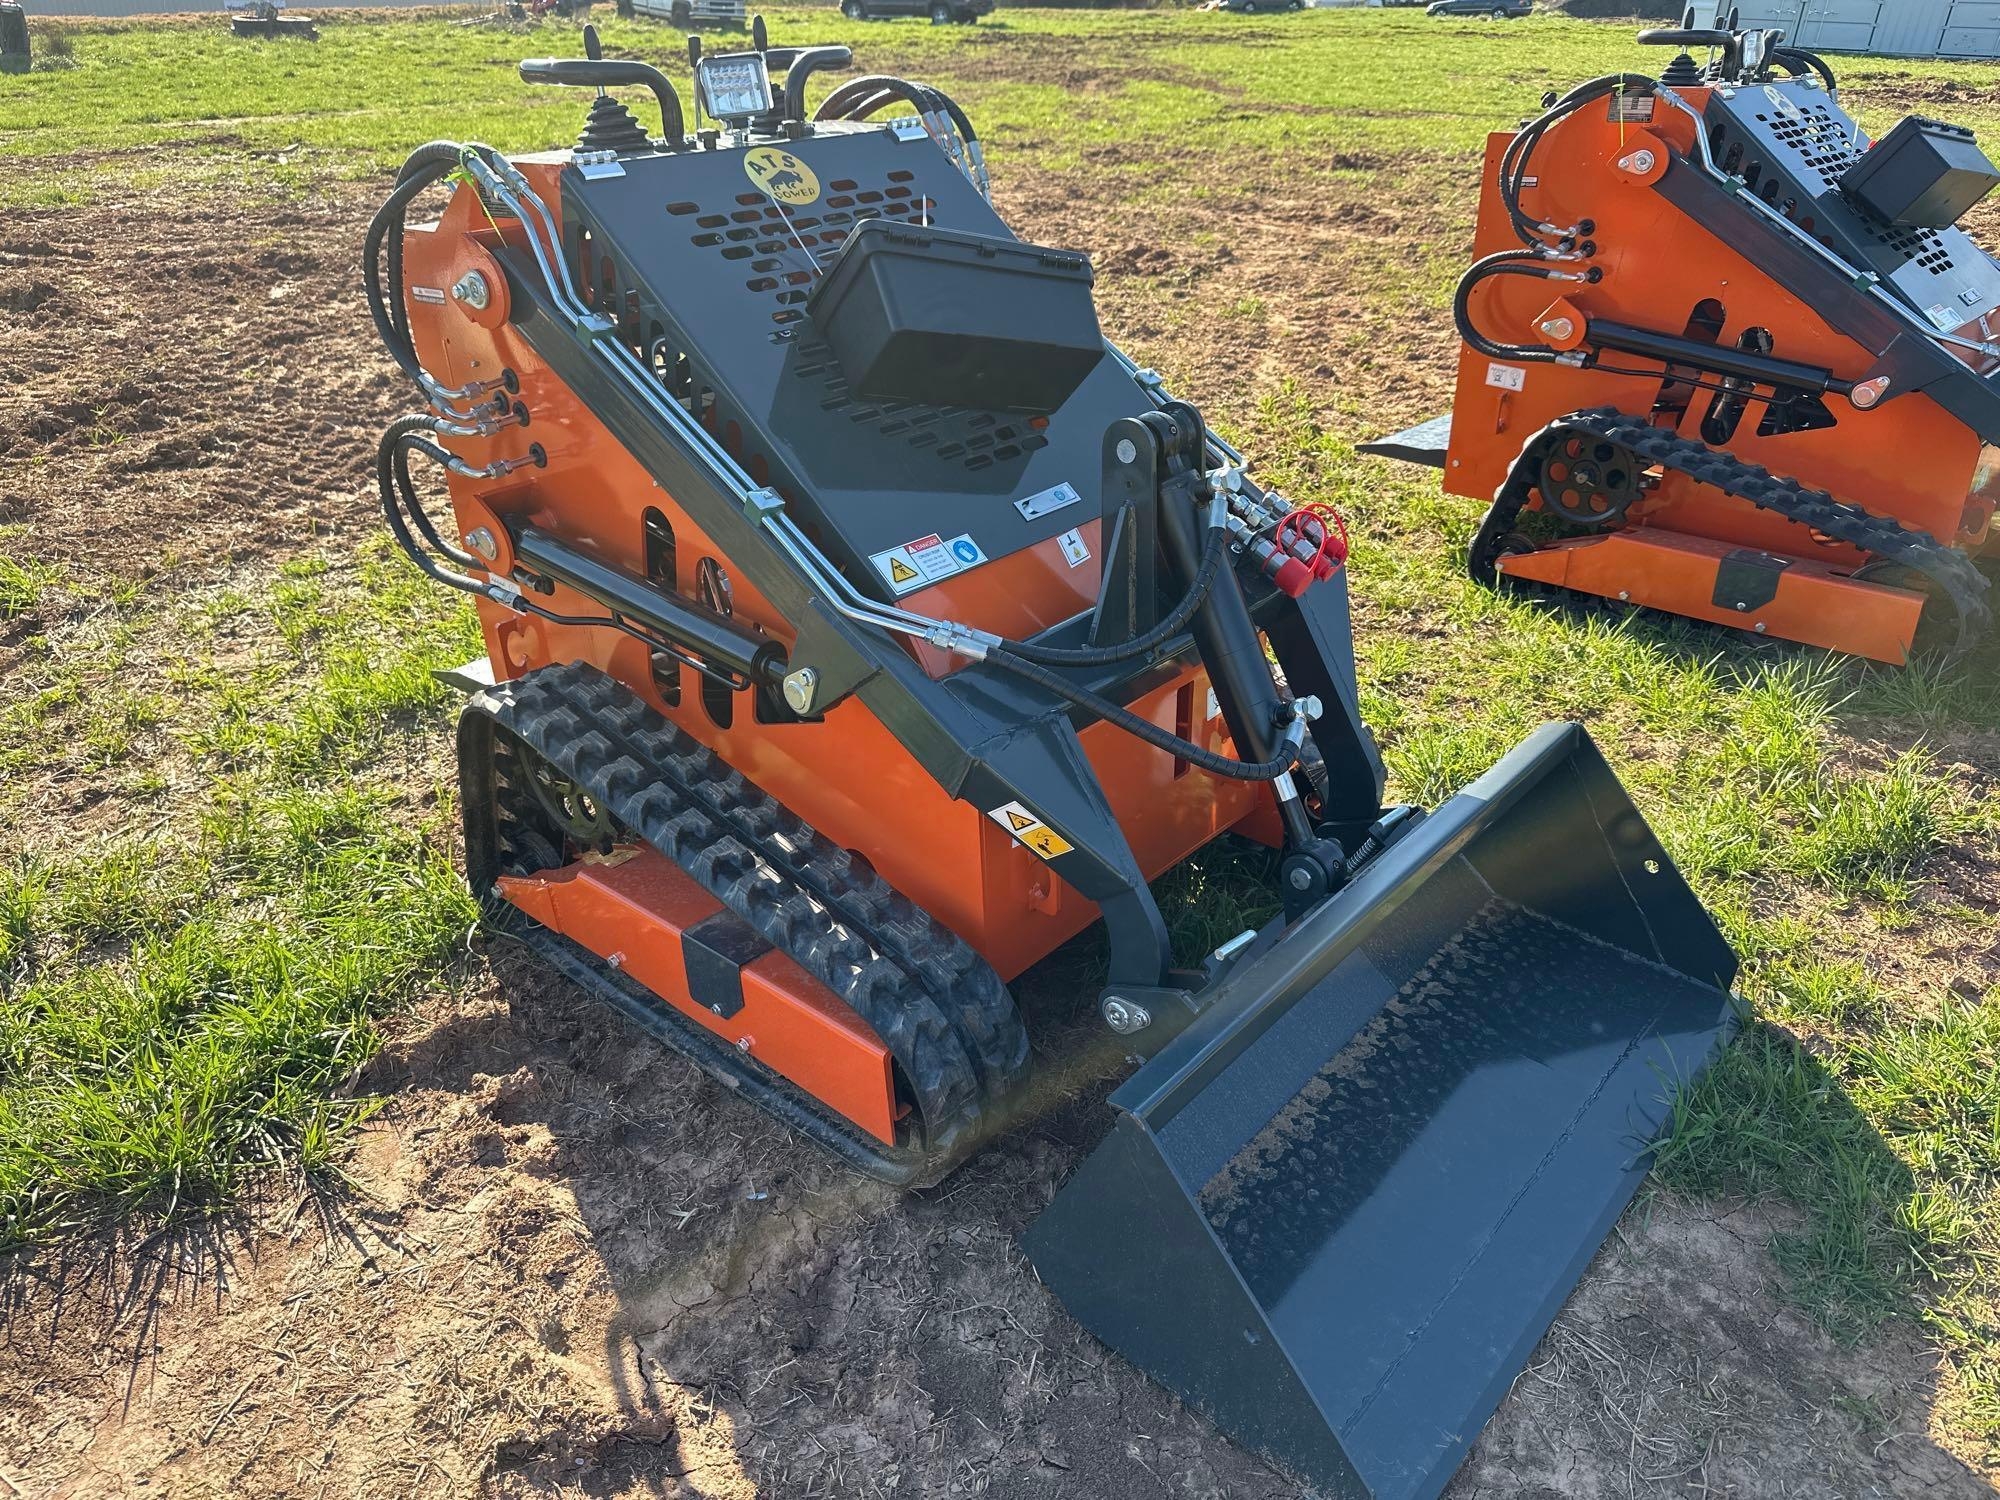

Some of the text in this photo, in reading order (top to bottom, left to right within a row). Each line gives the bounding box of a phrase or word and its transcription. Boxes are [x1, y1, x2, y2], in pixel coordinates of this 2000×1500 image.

[747, 154, 796, 176] ATS
[774, 187, 815, 200] POWER
[915, 538, 939, 551] DANGER
